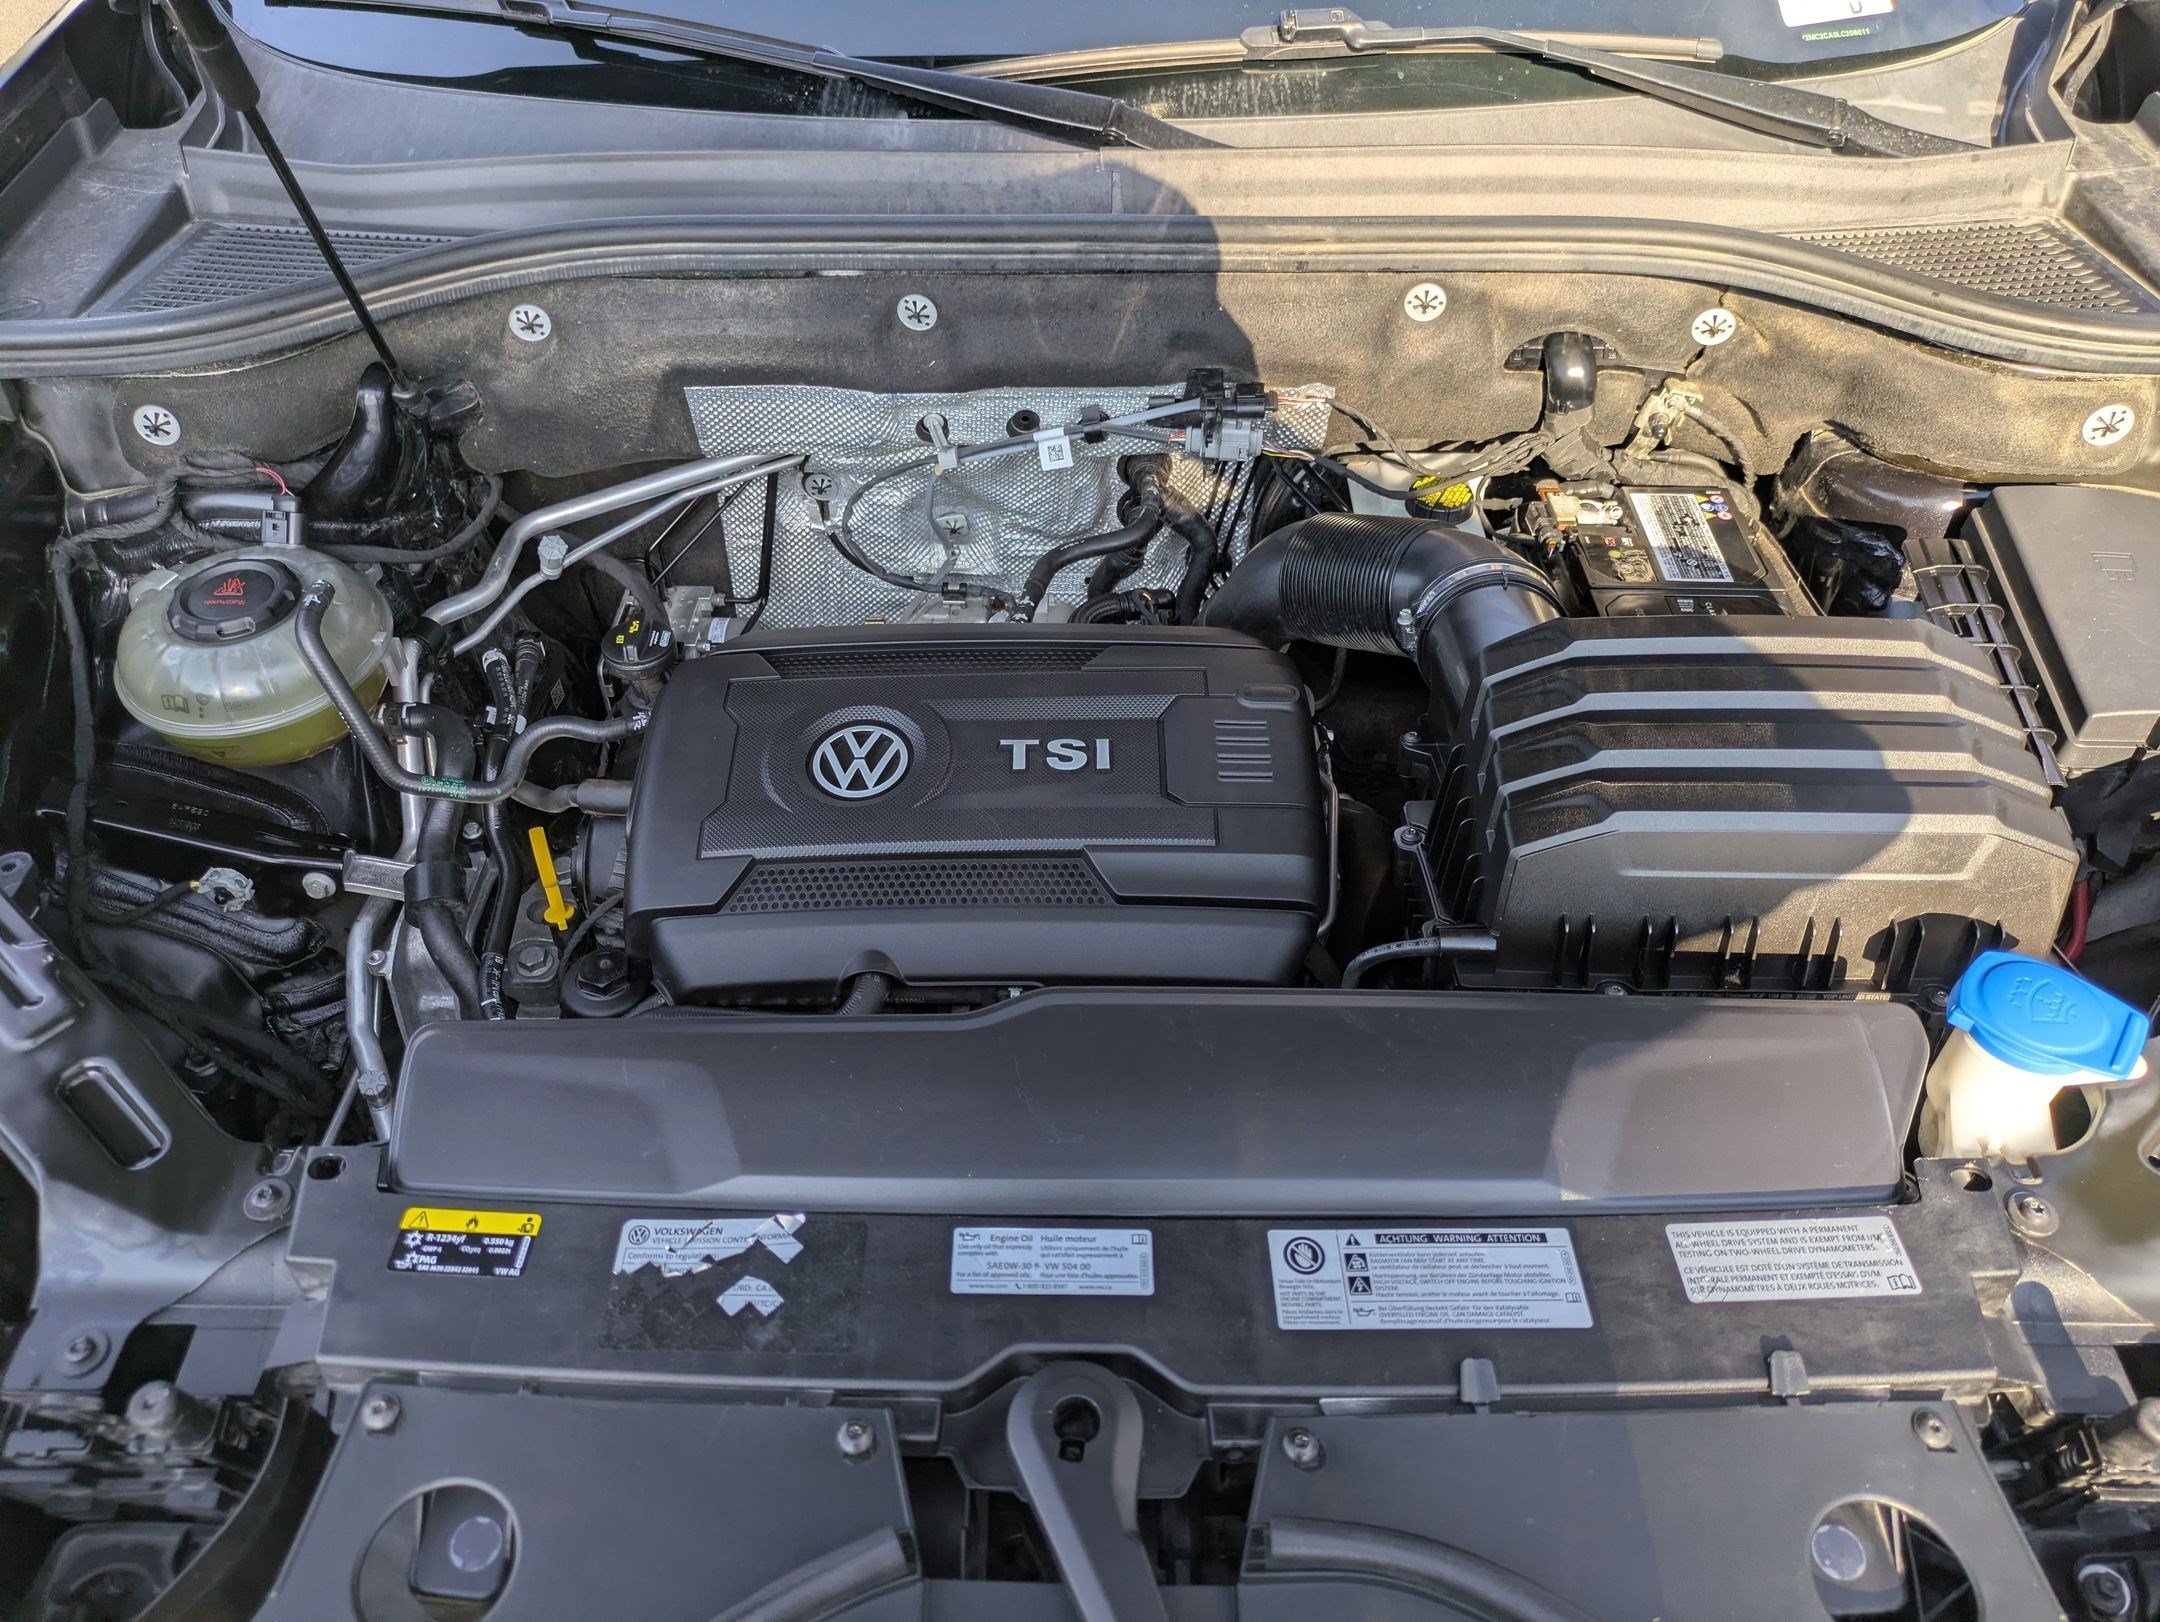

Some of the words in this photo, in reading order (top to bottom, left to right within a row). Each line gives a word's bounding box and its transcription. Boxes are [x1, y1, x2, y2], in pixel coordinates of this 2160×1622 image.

[1000, 738, 1112, 771] TSI
[1671, 1231, 1691, 1239] THIS
[1691, 1230, 1727, 1238] VEHICLE
[1737, 1228, 1777, 1236] EQUIPPED
[1809, 1225, 1859, 1233] PERMANENT
[990, 1234, 1018, 1244] Engine
[1020, 1234, 1033, 1242] Oil
[1040, 1235, 1062, 1243] Huile
[1379, 1235, 1428, 1243] ACHTUNG
[1432, 1234, 1483, 1242] WARNING
[1486, 1234, 1541, 1242] ATTENTION
[1747, 1238, 1779, 1246] SYSTEM
[628, 1251, 663, 1259] Conforms
[1679, 1250, 1713, 1258] TESTING
[1729, 1247, 1782, 1256] TWO-WHEEL
[1808, 1244, 1878, 1253] DYNAMOMETERS.
[419, 1255, 438, 1264] PAG
[1695, 1265, 1735, 1274] VÉHICULE
[1774, 1263, 1796, 1271] D'UN
[1831, 1261, 1842, 1269] DE
[1844, 1259, 1904, 1268] TRANSMISSION
[1730, 1274, 1779, 1282] PERMANENT
[1780, 1273, 1789, 1281] ET
[1827, 1271, 1858, 1279] D'ESSAIS
[1785, 1283, 1807, 1291] DEUX
[1808, 1282, 1836, 1290] ROUES
